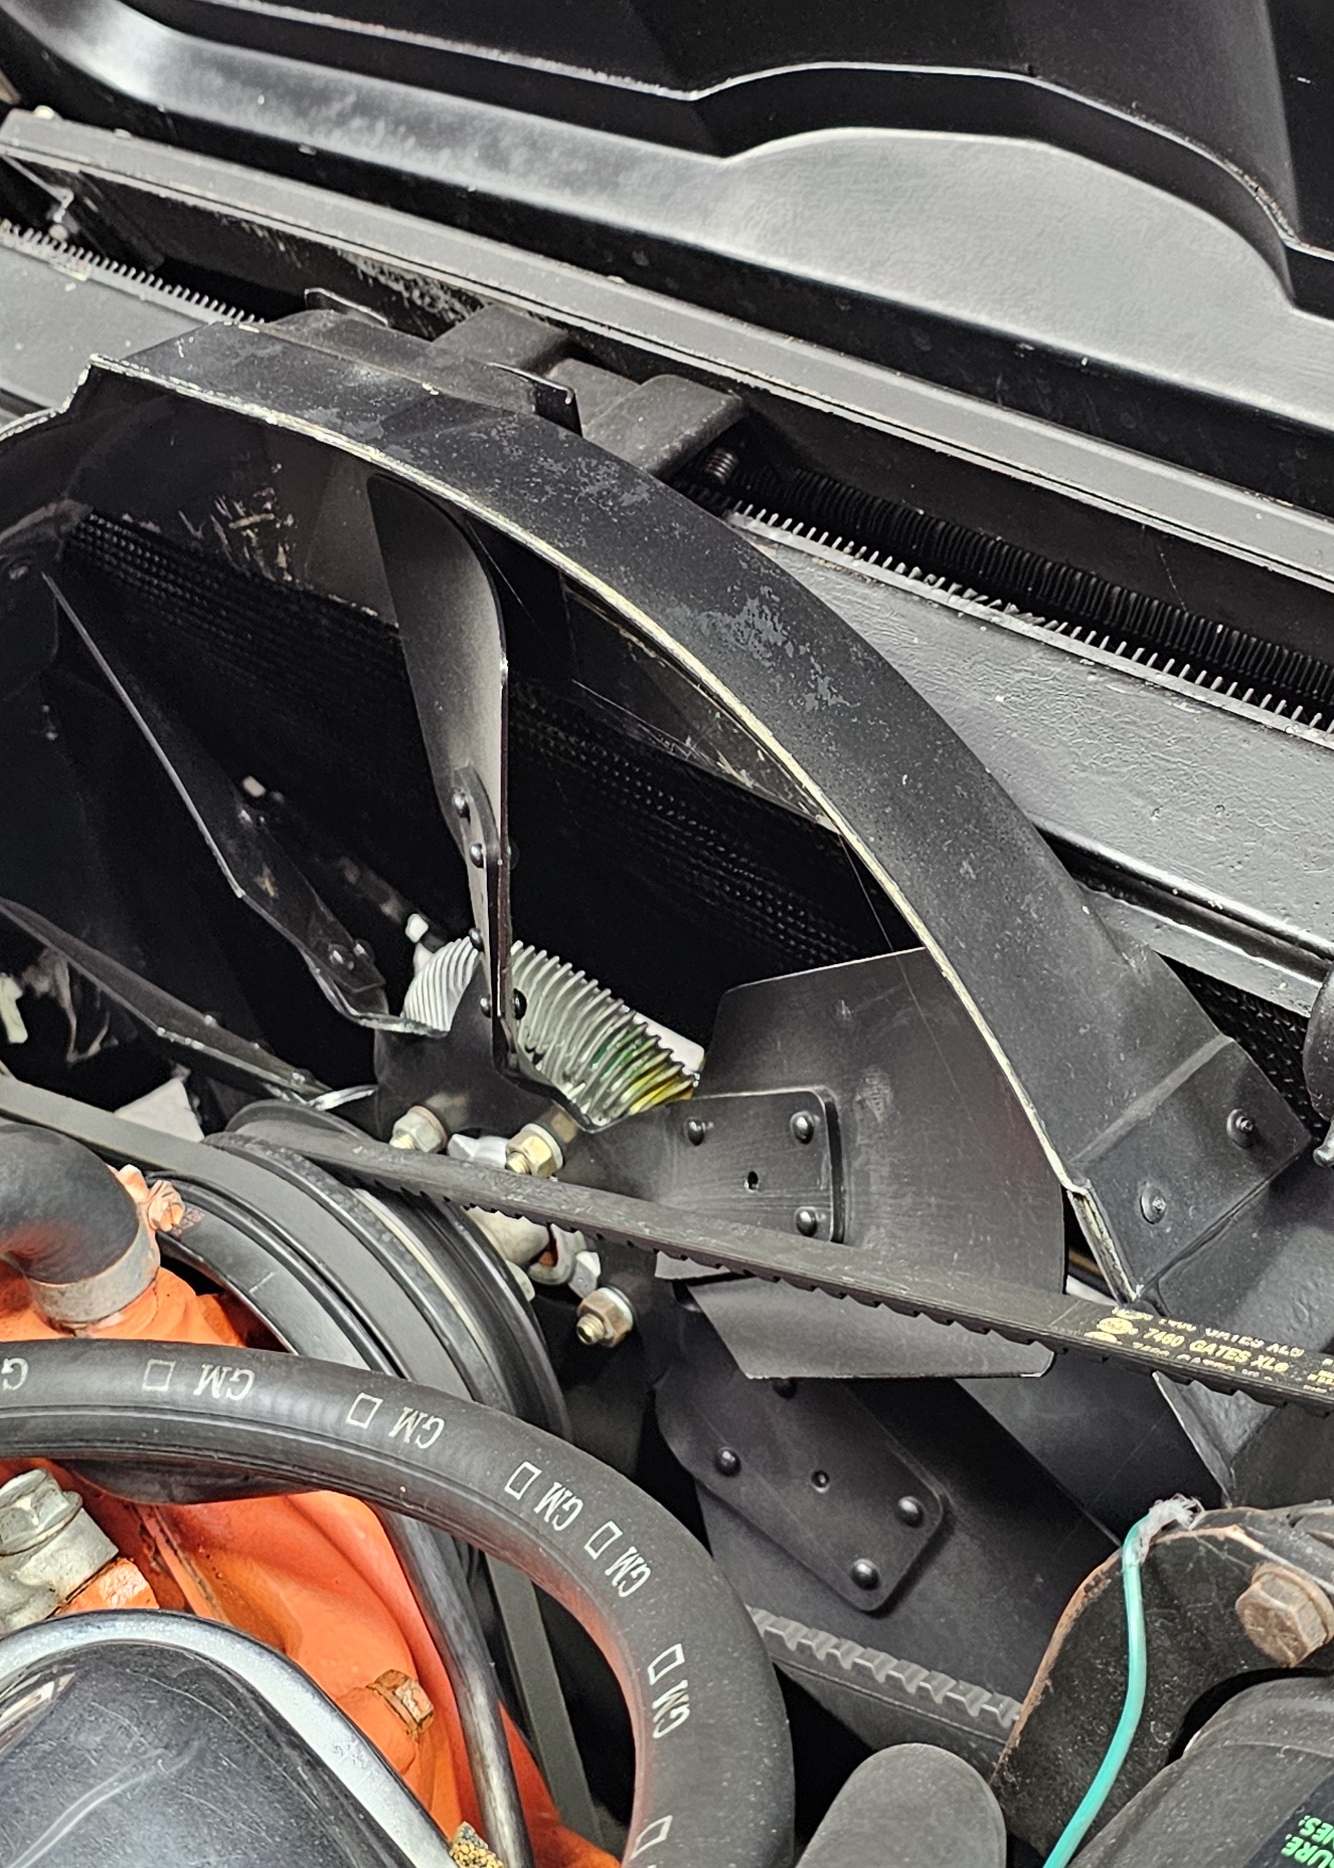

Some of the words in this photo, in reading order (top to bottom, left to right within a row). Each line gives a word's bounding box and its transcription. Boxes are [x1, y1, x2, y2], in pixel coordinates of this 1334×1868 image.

[1143, 1328, 1185, 1348] 7460
[1189, 1340, 1252, 1364] GATES
[192, 1363, 255, 1401] GM
[388, 1406, 446, 1450] GM
[534, 1481, 584, 1532] GM
[604, 1545, 652, 1598] GM
[651, 1679, 691, 1739] GM
